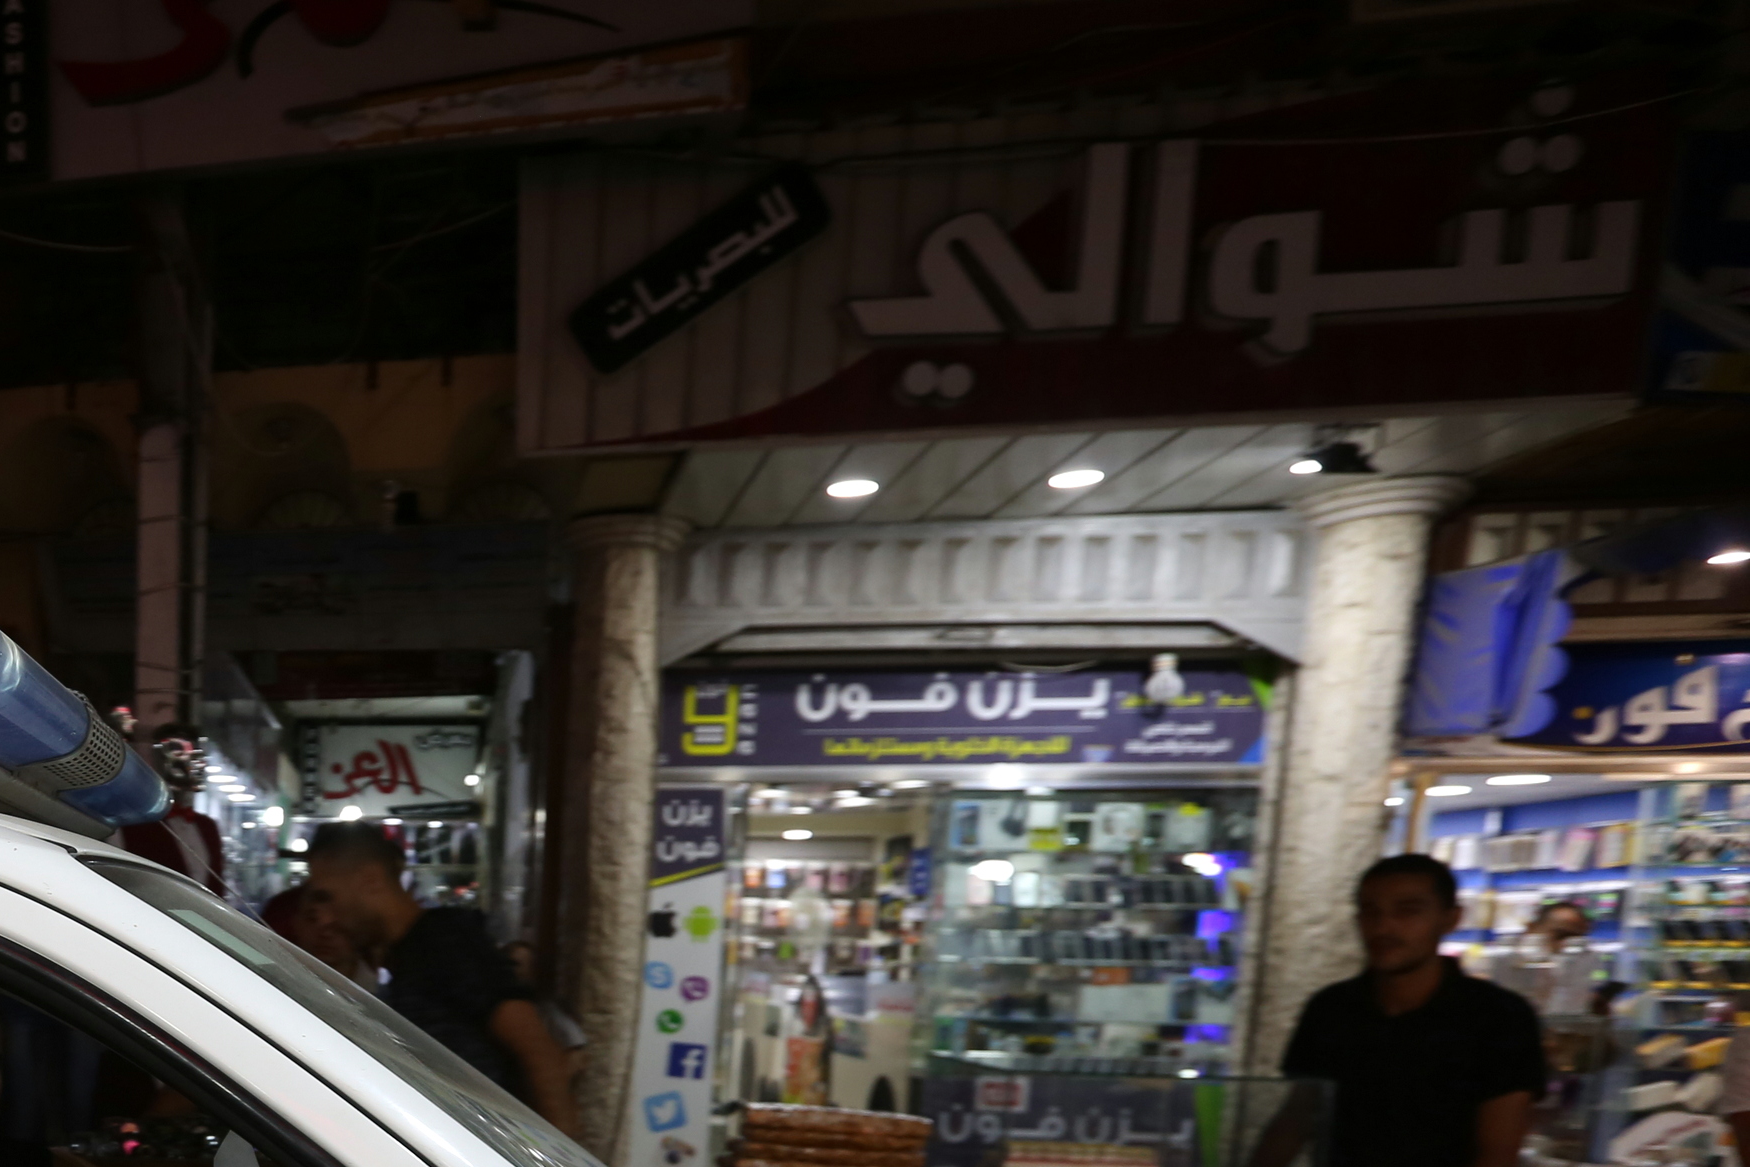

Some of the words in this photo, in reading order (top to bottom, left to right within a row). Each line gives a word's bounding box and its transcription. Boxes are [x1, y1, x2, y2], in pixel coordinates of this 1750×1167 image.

[605, 184, 798, 344] للبصريات
[795, 673, 958, 721] فون
[966, 671, 1111, 721] يزن
[661, 798, 713, 827] يزن
[655, 834, 720, 863] فون
[938, 1105, 1066, 1144] فون
[1074, 1107, 1195, 1147] يزن
